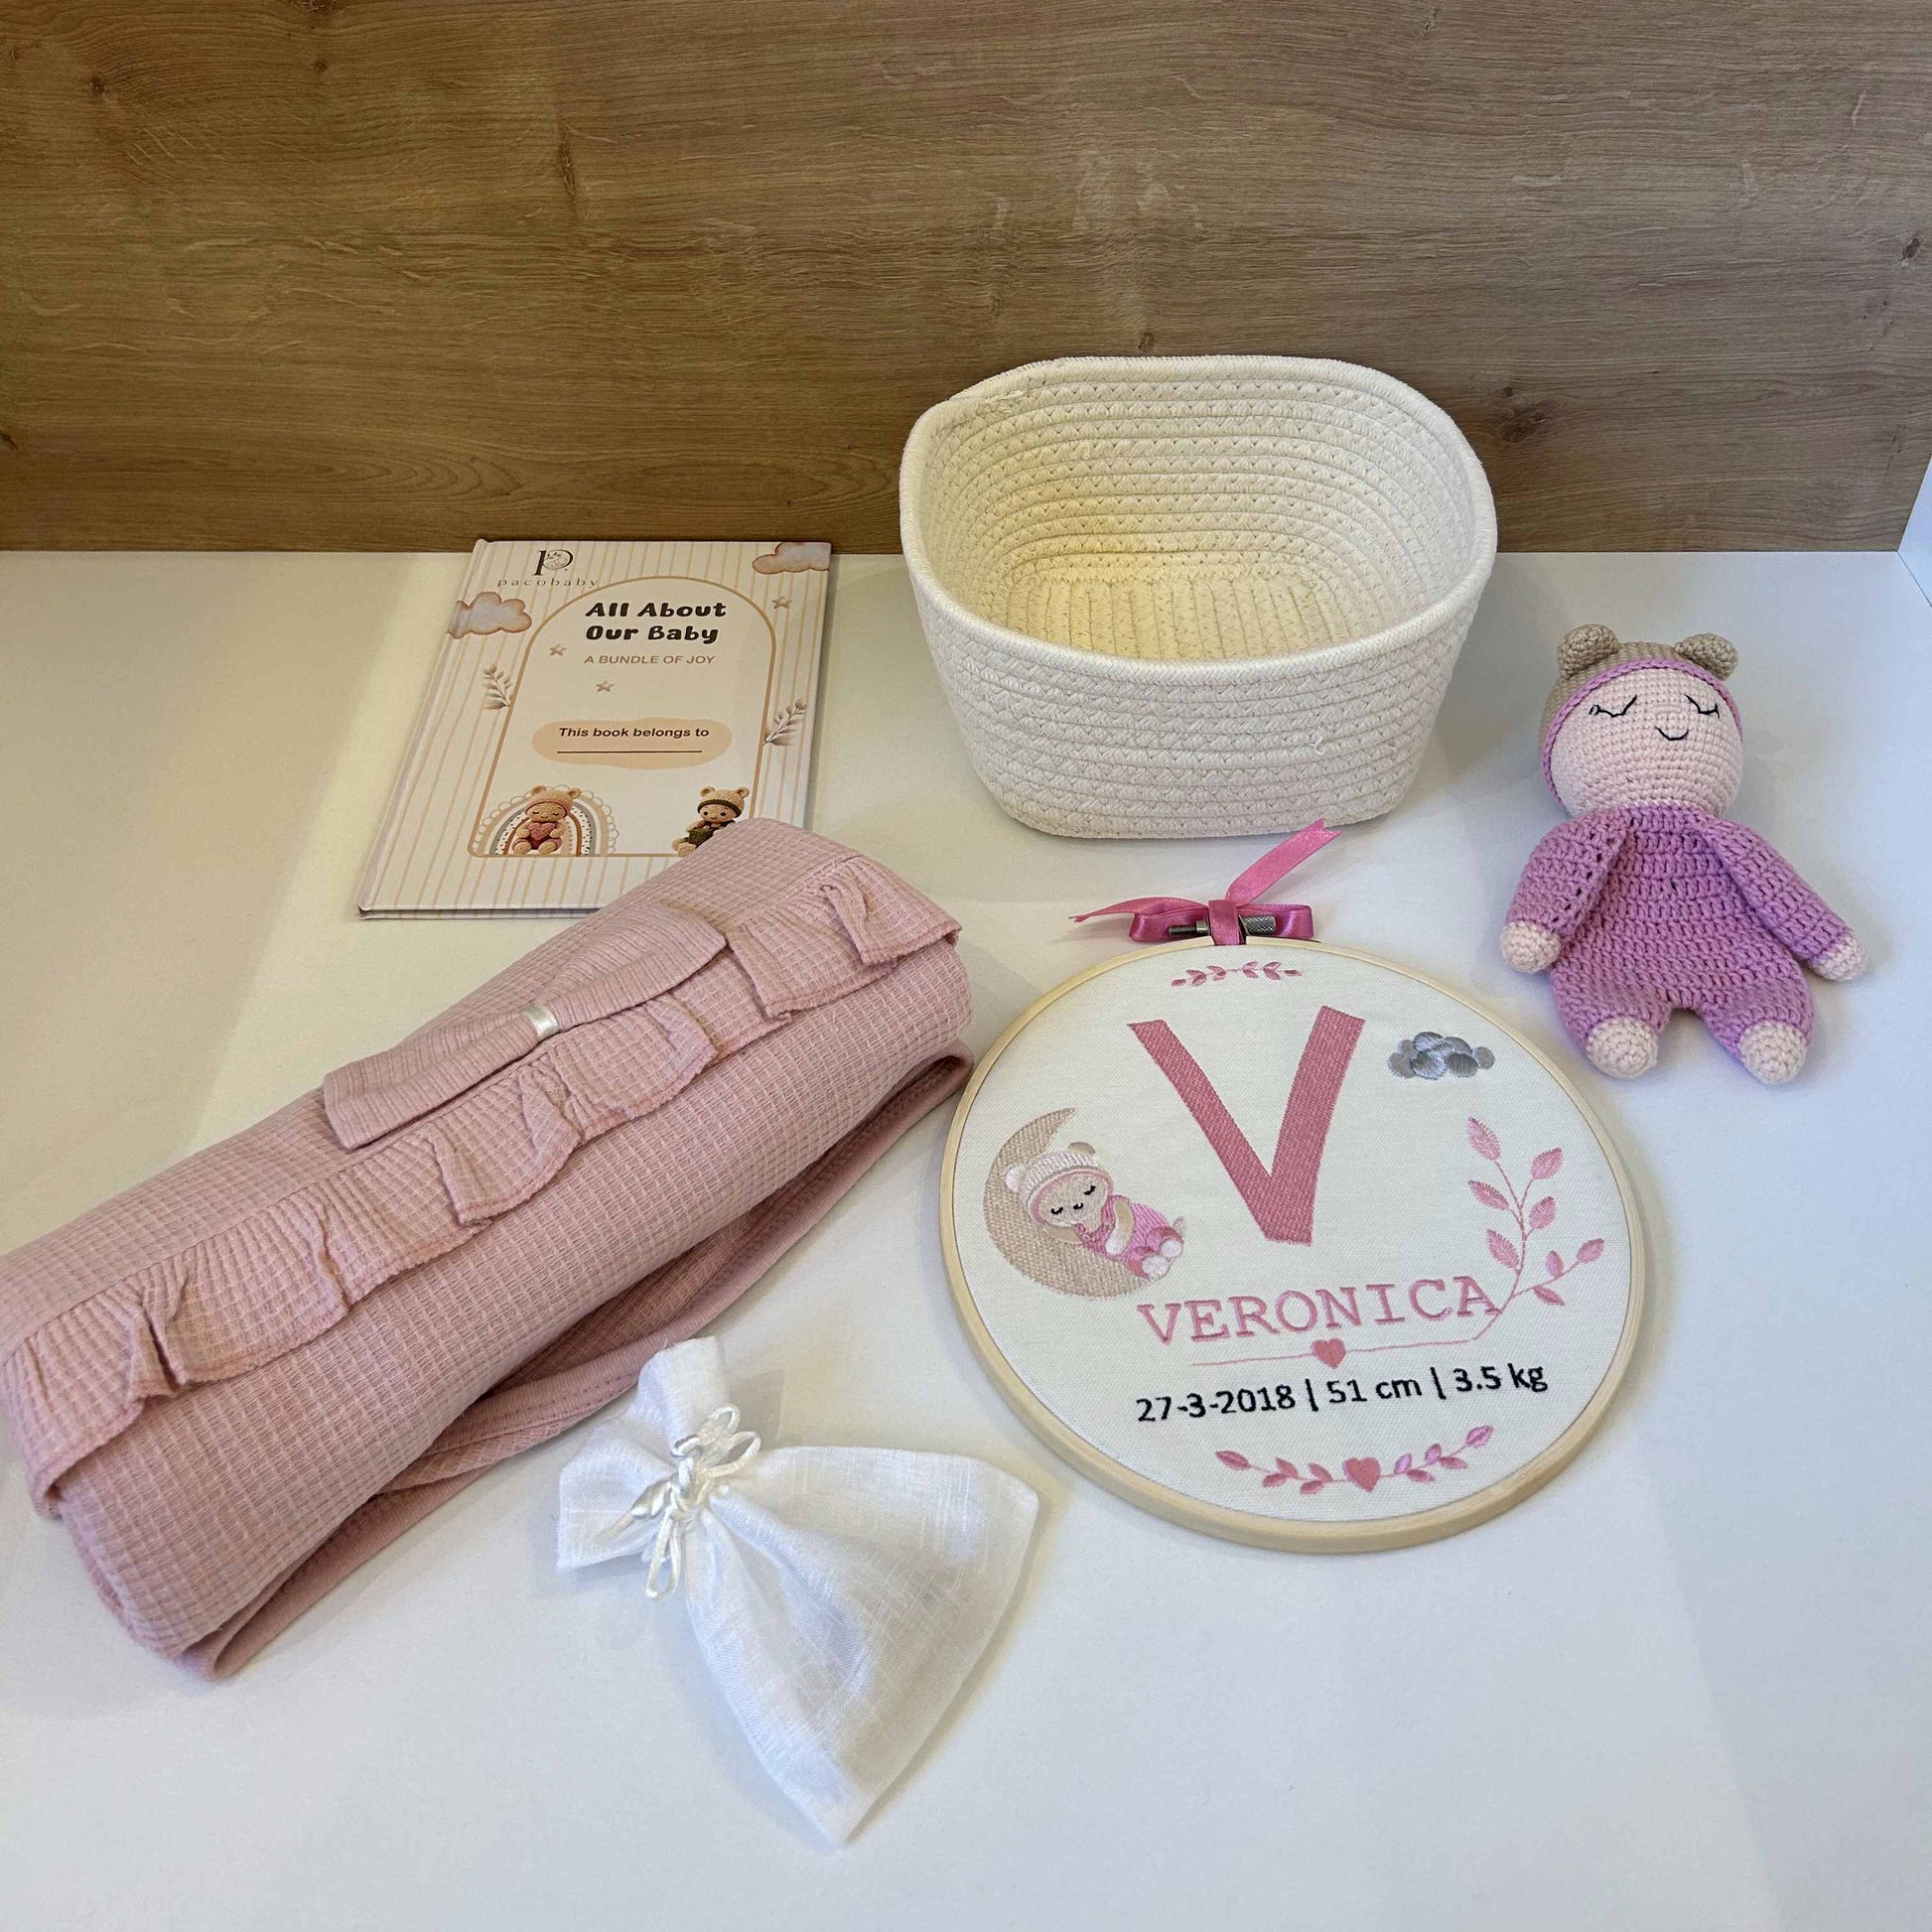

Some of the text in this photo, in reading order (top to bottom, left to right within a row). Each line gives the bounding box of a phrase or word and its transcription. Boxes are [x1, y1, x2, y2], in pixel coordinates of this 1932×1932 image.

[497, 577, 600, 588] pacobaby
[585, 602, 727, 618] All About
[585, 624, 719, 644] Our Baby
[584, 655, 716, 664] A BUNDLE OF JOY
[559, 727, 710, 741] This book belongs to
[1127, 1005, 1366, 1247] V
[1137, 1276, 1501, 1345] VERONICA
[1137, 1383, 1297, 1423] 27-3-2018
[1327, 1379, 1368, 1404] 51
[1376, 1378, 1423, 1401] cm
[1451, 1365, 1502, 1392] 3.5
[1507, 1363, 1549, 1392] kg
